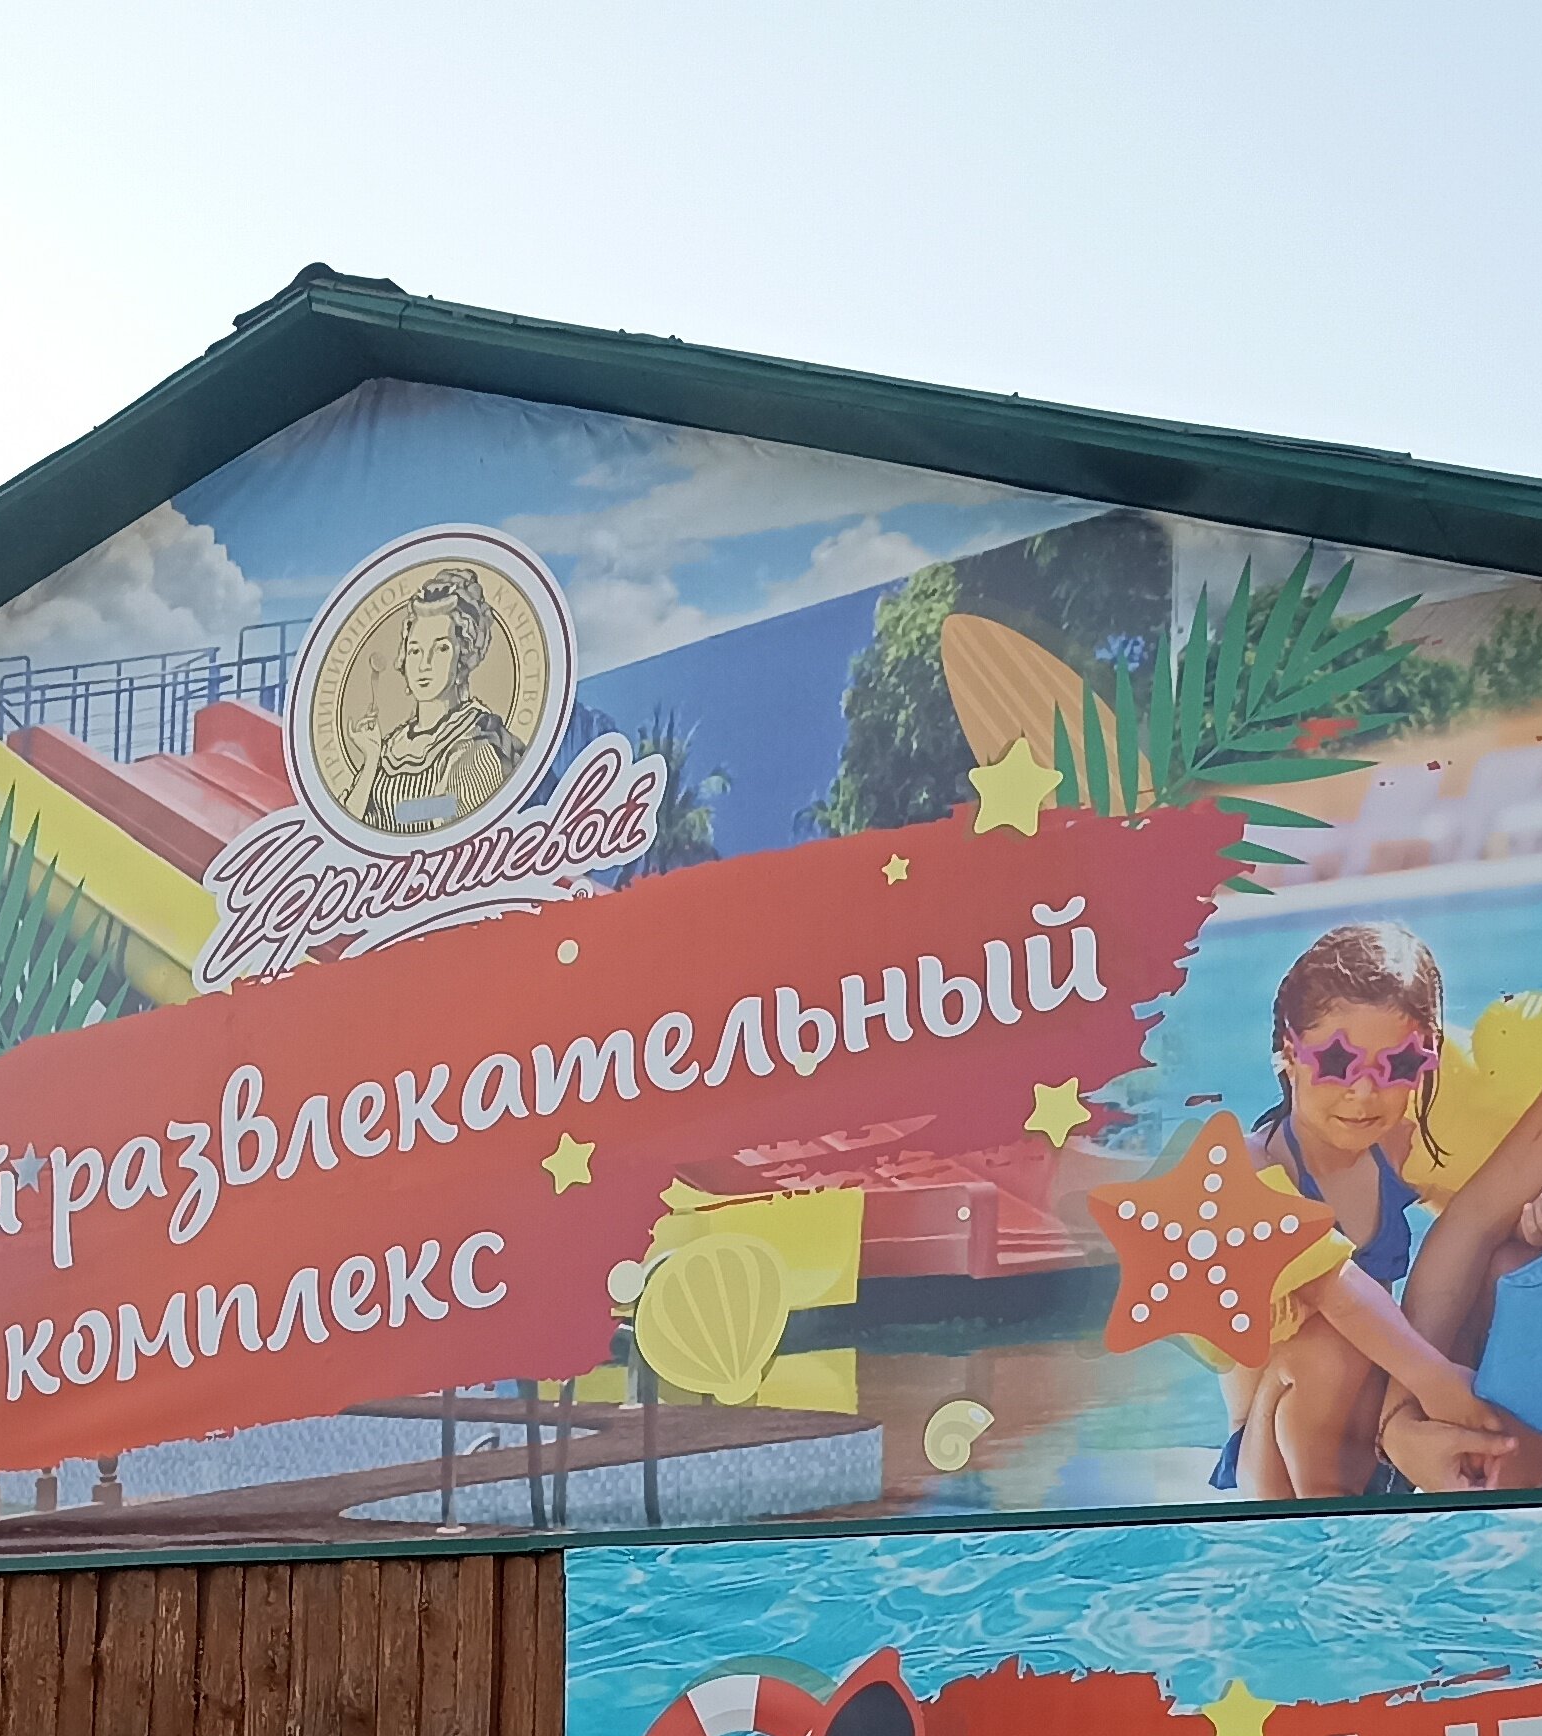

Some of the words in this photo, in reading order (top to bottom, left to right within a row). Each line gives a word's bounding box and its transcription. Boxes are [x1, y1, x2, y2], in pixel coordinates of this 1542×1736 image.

[317, 577, 412, 786] ТРАДИЦИОННОЕ
[493, 582, 542, 727] КАЧЕСТВО
[202, 747, 656, 984] Чернышевой
[51, 895, 1108, 1269] развлекательный
[5, 1229, 508, 1402] комплекс
